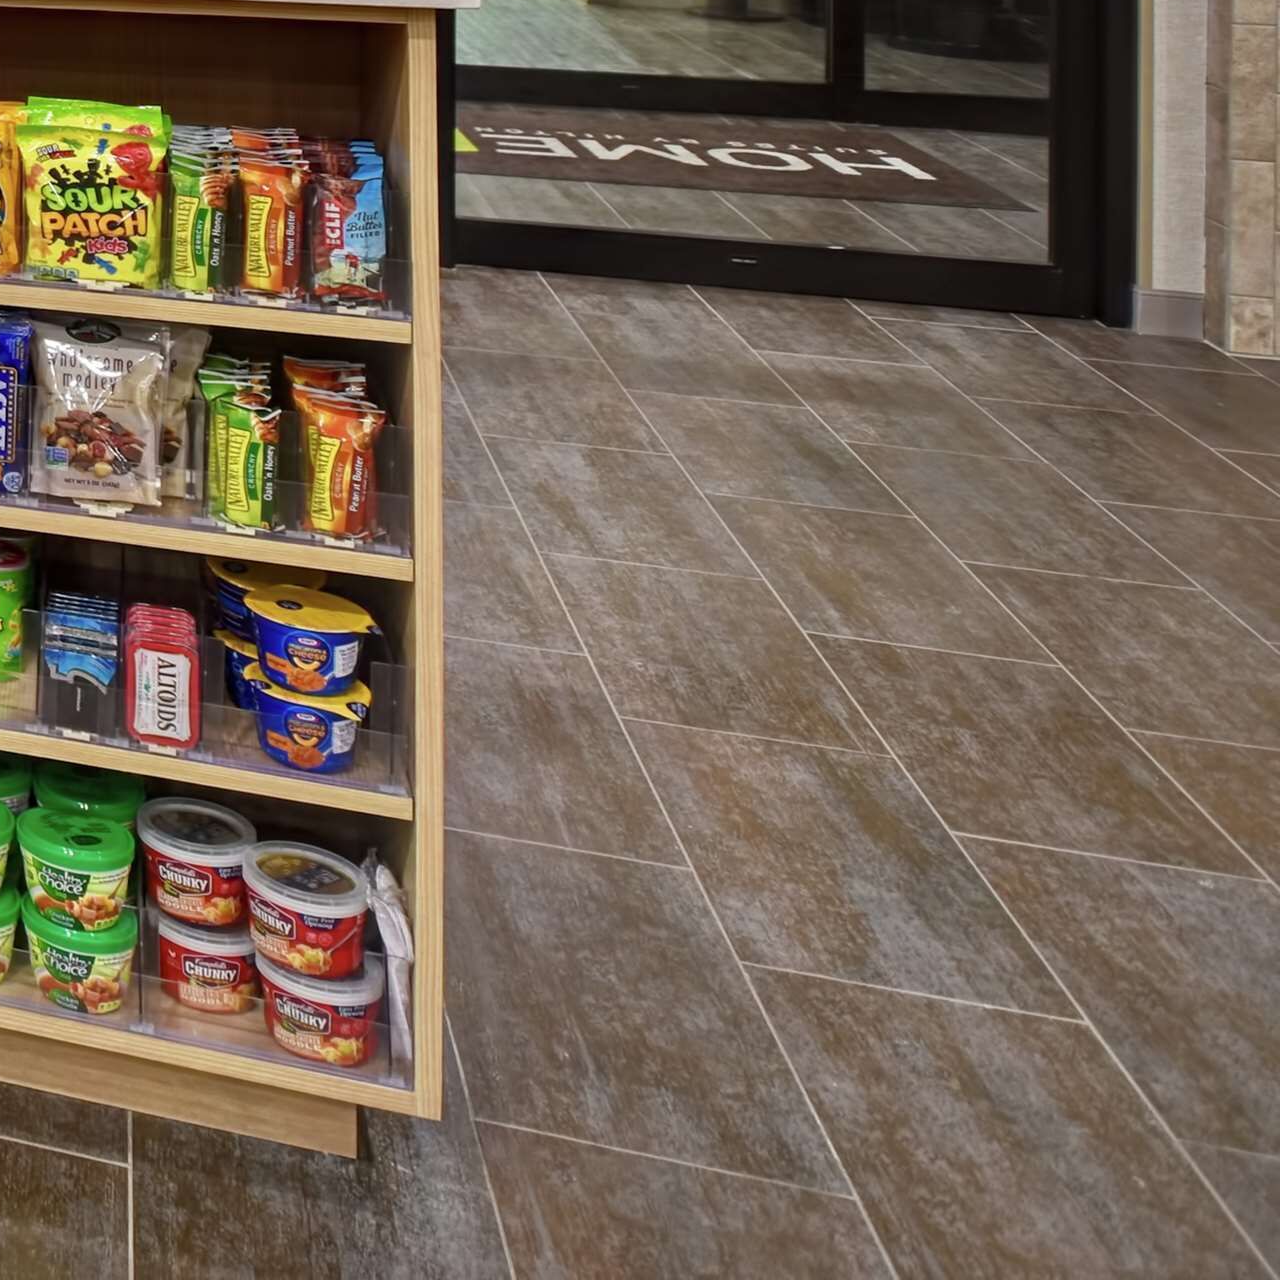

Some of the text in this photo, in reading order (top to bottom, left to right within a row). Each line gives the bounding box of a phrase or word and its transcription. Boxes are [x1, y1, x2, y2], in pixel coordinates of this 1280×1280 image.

[480, 132, 937, 180] HOME
[42, 185, 138, 212] SOUR
[42, 209, 146, 239] PATCH
[176, 198, 190, 274] NATURE VALLEY
[211, 212, 224, 266] Oats Honey
[248, 198, 267, 274] NATURE VALLEY
[285, 210, 295, 265] Peanut Butter
[62, 372, 118, 391] medley
[229, 429, 249, 510] NATURE VALLEY
[264, 445, 275, 501] Oats Honey
[313, 439, 338, 518] NATURE VALLEY
[352, 456, 363, 482] Butter
[157, 656, 176, 733] ALTOIDS
[159, 865, 208, 891] CHUNKY
[186, 963, 236, 981] CHUNKY
[277, 998, 326, 1030] CHUNKY
